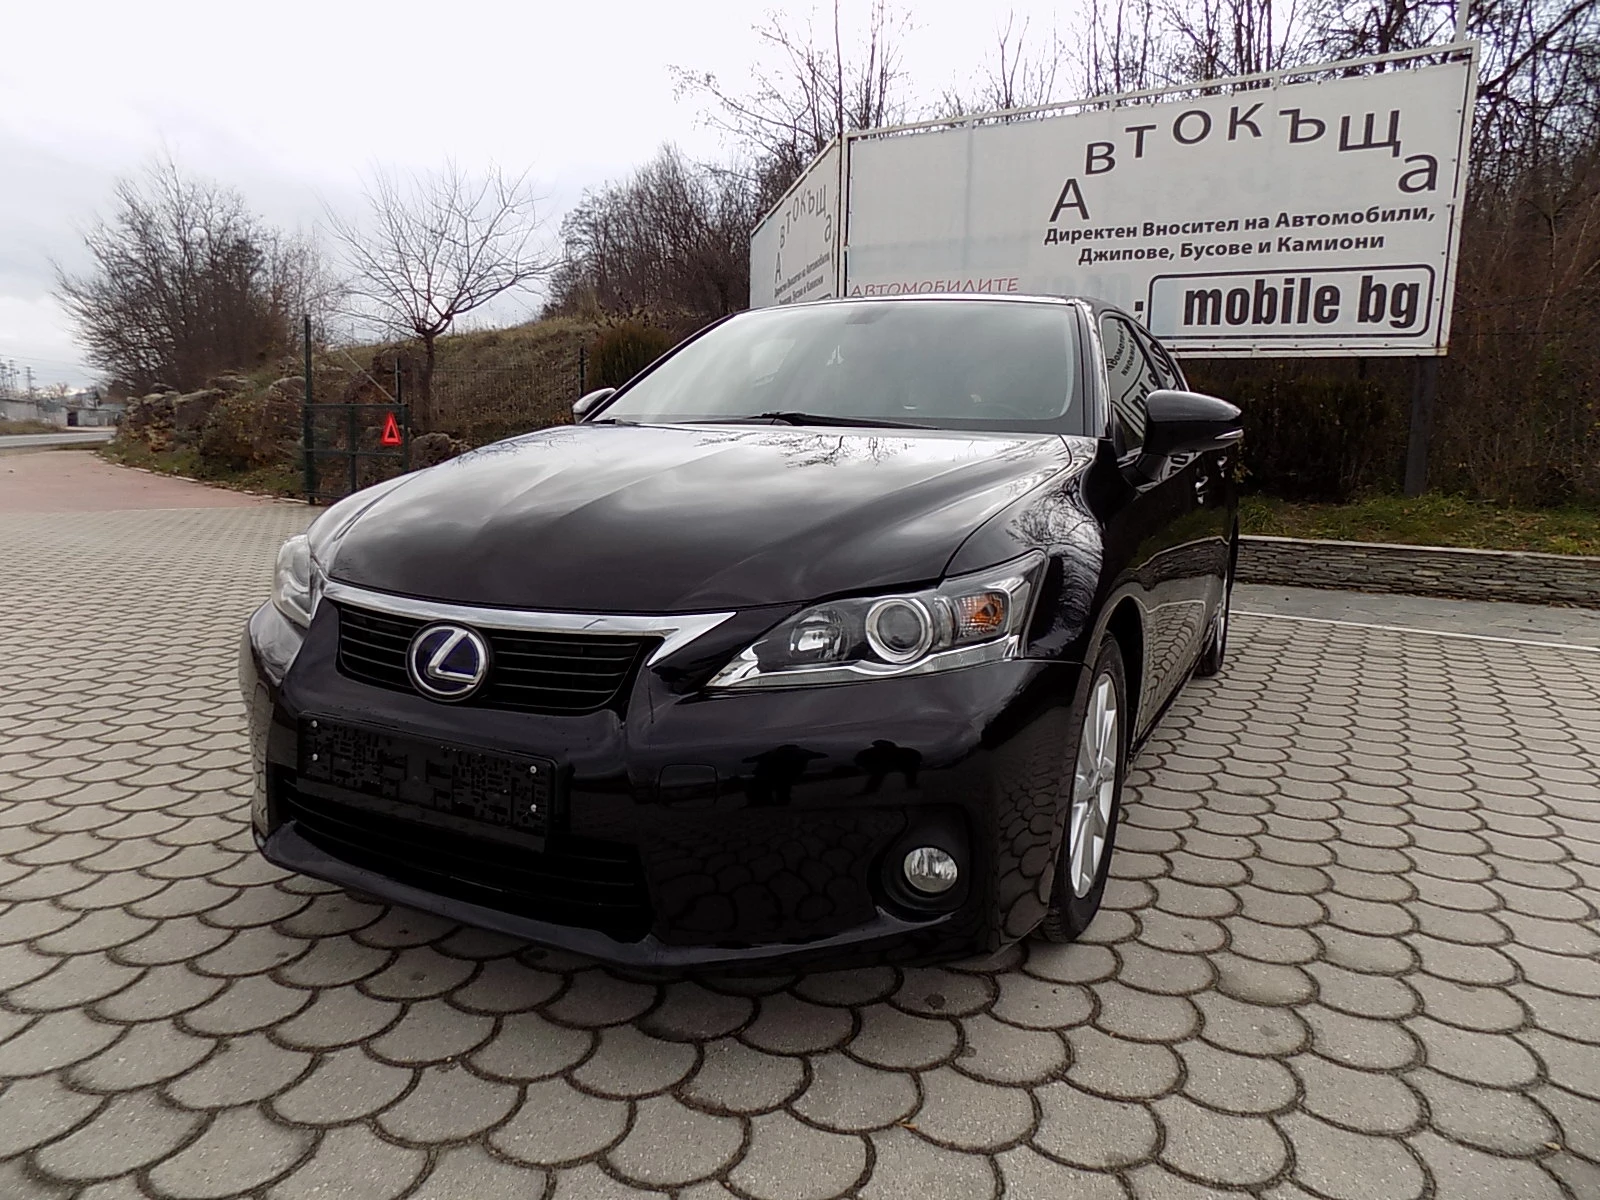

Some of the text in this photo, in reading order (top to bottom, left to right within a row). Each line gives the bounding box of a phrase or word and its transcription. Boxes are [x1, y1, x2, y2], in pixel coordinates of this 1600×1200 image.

[1044, 206, 1435, 246] Директен Вносител на Автомобили,
[1078, 236, 1385, 266] Джипове, Бусове и Камиони
[851, 278, 1018, 297] АВТОМОБИЛИТЕ
[1183, 277, 1341, 326] mobile
[1357, 275, 1420, 329] bg
